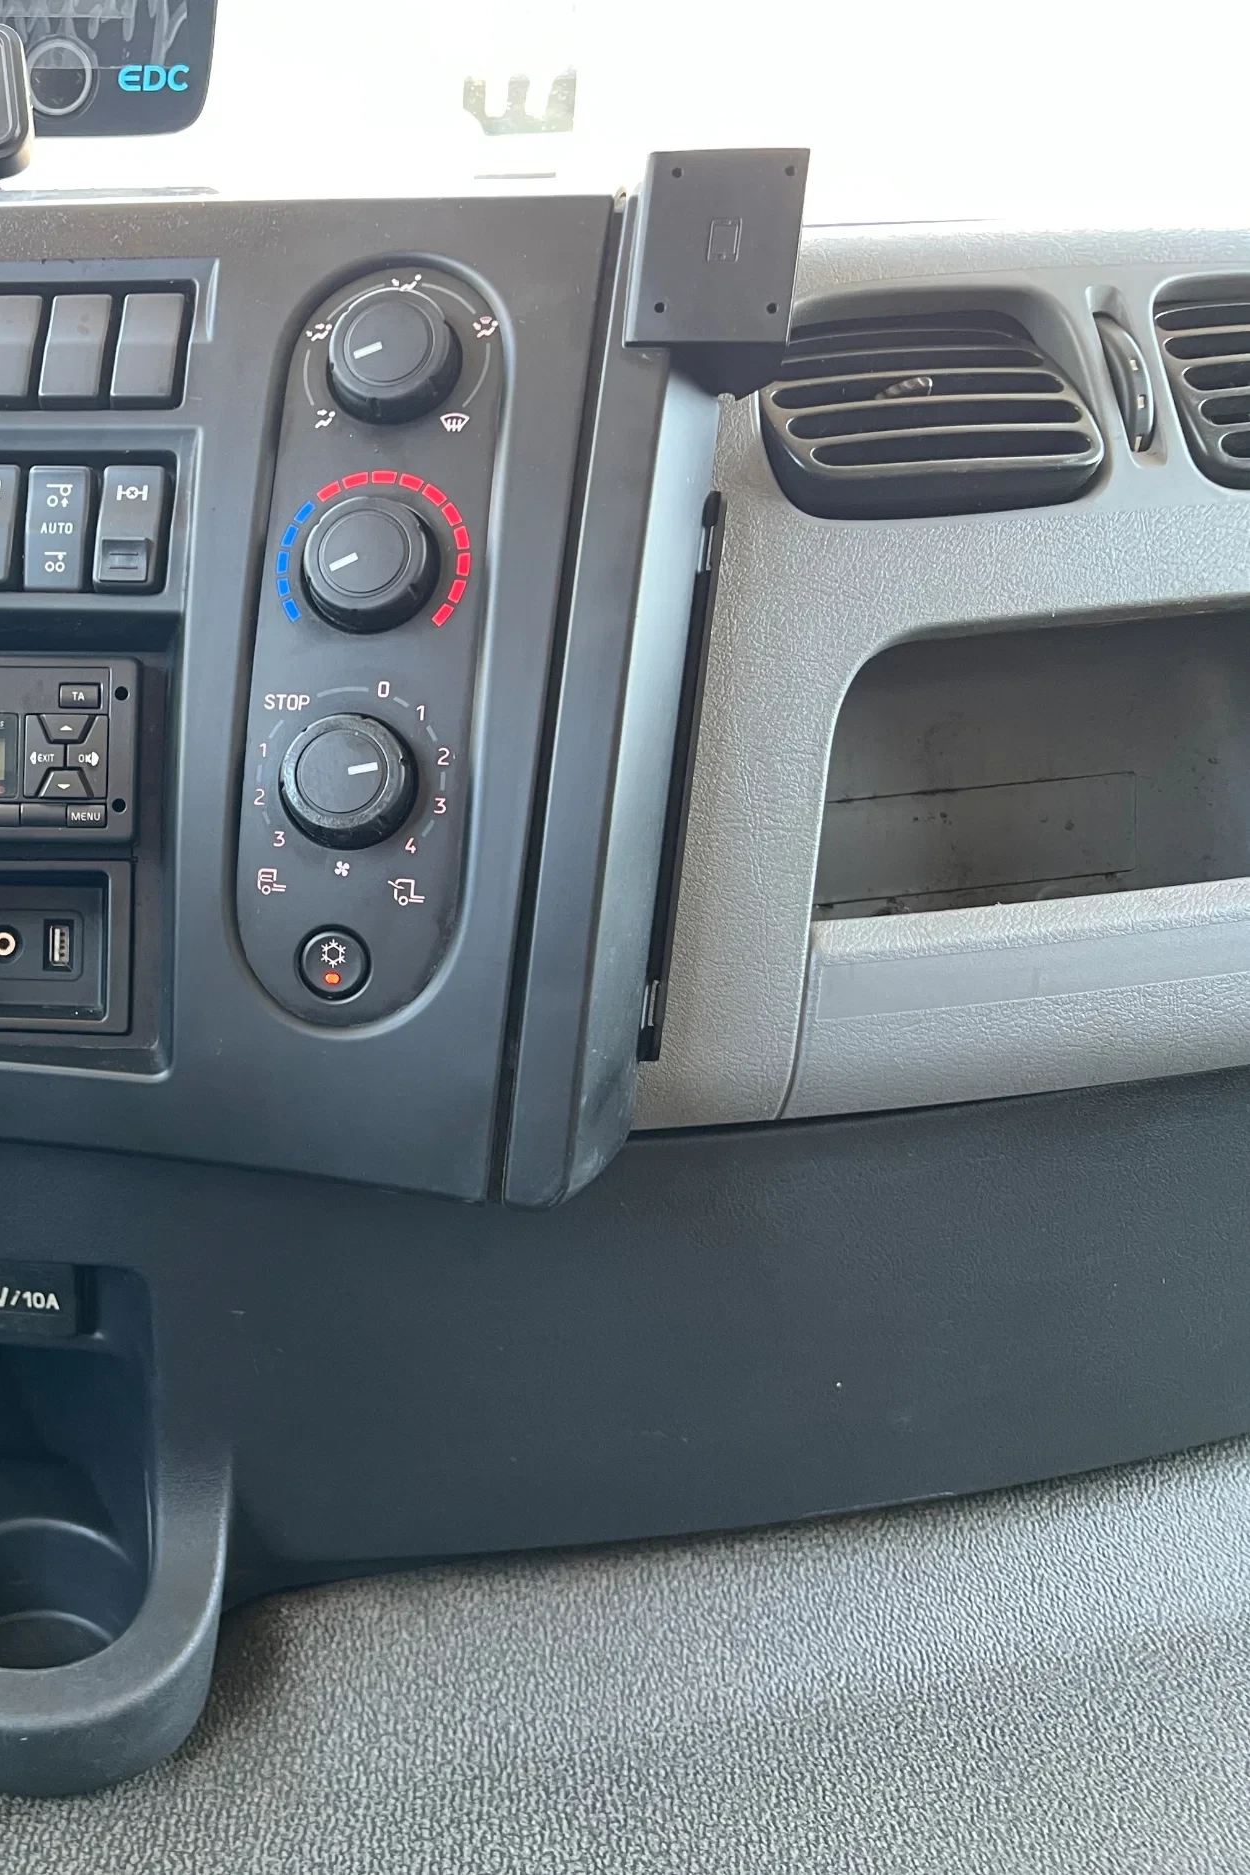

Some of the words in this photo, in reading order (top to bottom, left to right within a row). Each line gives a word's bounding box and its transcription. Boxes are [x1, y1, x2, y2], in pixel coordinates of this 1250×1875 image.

[117, 64, 190, 92] EDC
[40, 522, 73, 534] AUTO
[72, 691, 85, 701] TA
[377, 681, 390, 698] 0
[263, 693, 311, 711] STOP
[416, 705, 426, 721] 1
[259, 743, 267, 757] 1
[437, 748, 450, 766] 2
[37, 754, 55, 763] EXIT
[78, 754, 92, 764] OK
[253, 788, 265, 806] 2
[433, 797, 447, 814] 3
[71, 812, 101, 821] MENU
[273, 831, 286, 847] 3
[404, 838, 417, 854] 4
